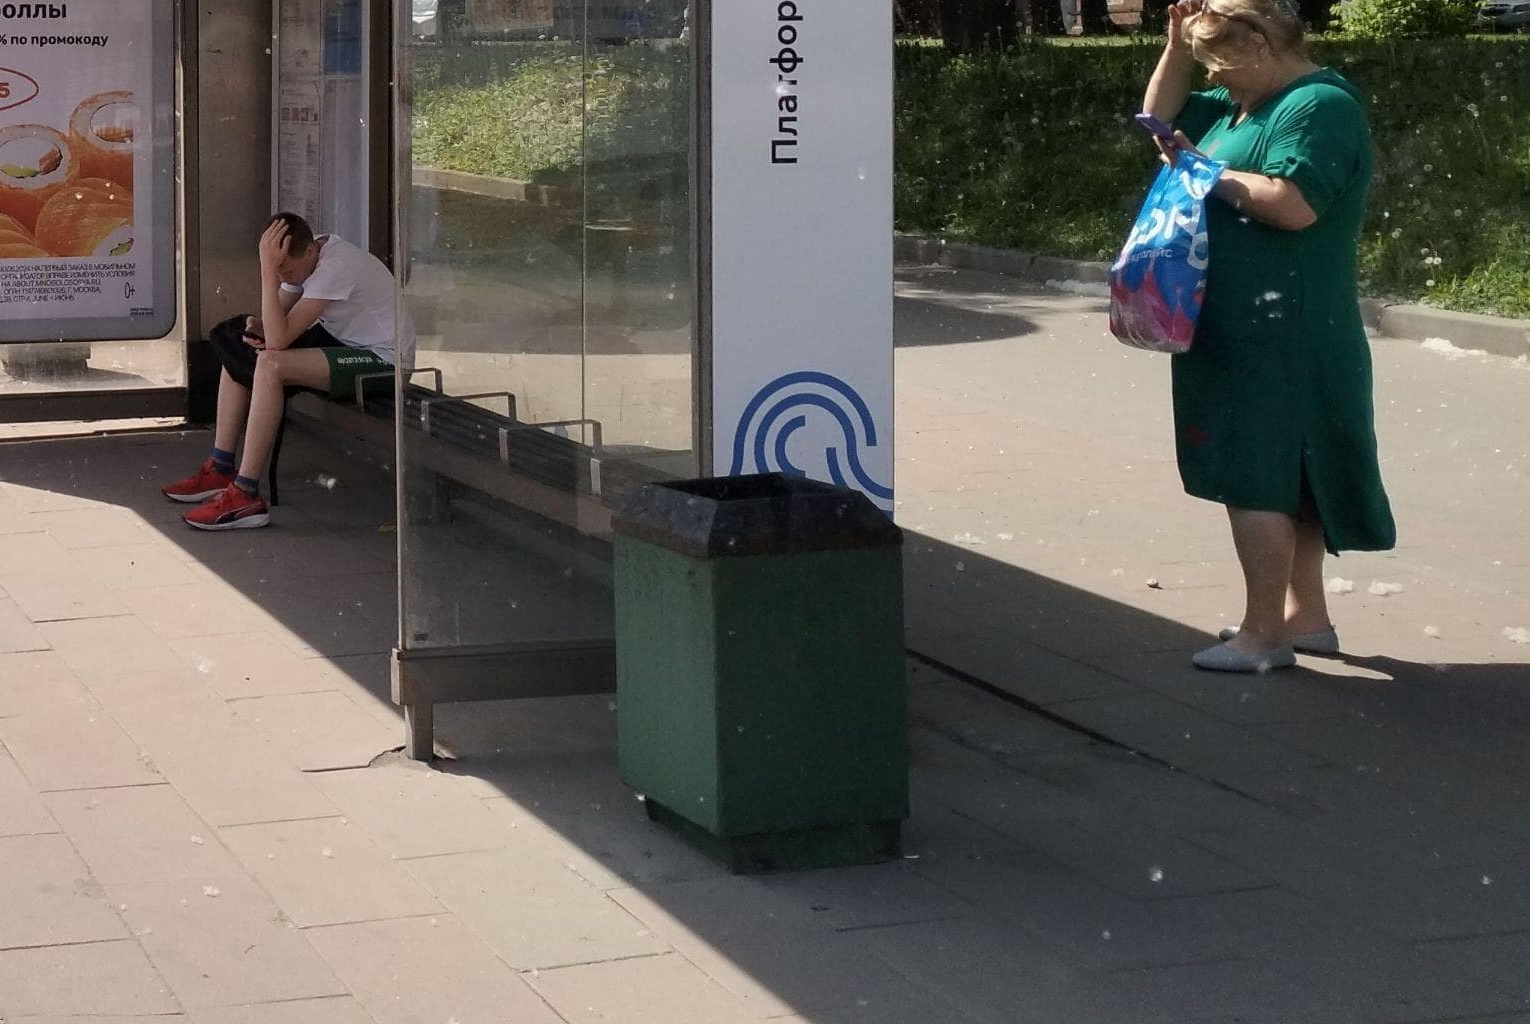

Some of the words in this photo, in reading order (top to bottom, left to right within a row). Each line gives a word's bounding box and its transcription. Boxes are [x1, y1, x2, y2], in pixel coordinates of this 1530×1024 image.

[10, 35, 28, 46] по
[30, 35, 109, 48] промокоду
[125, 282, 135, 299] 0+
